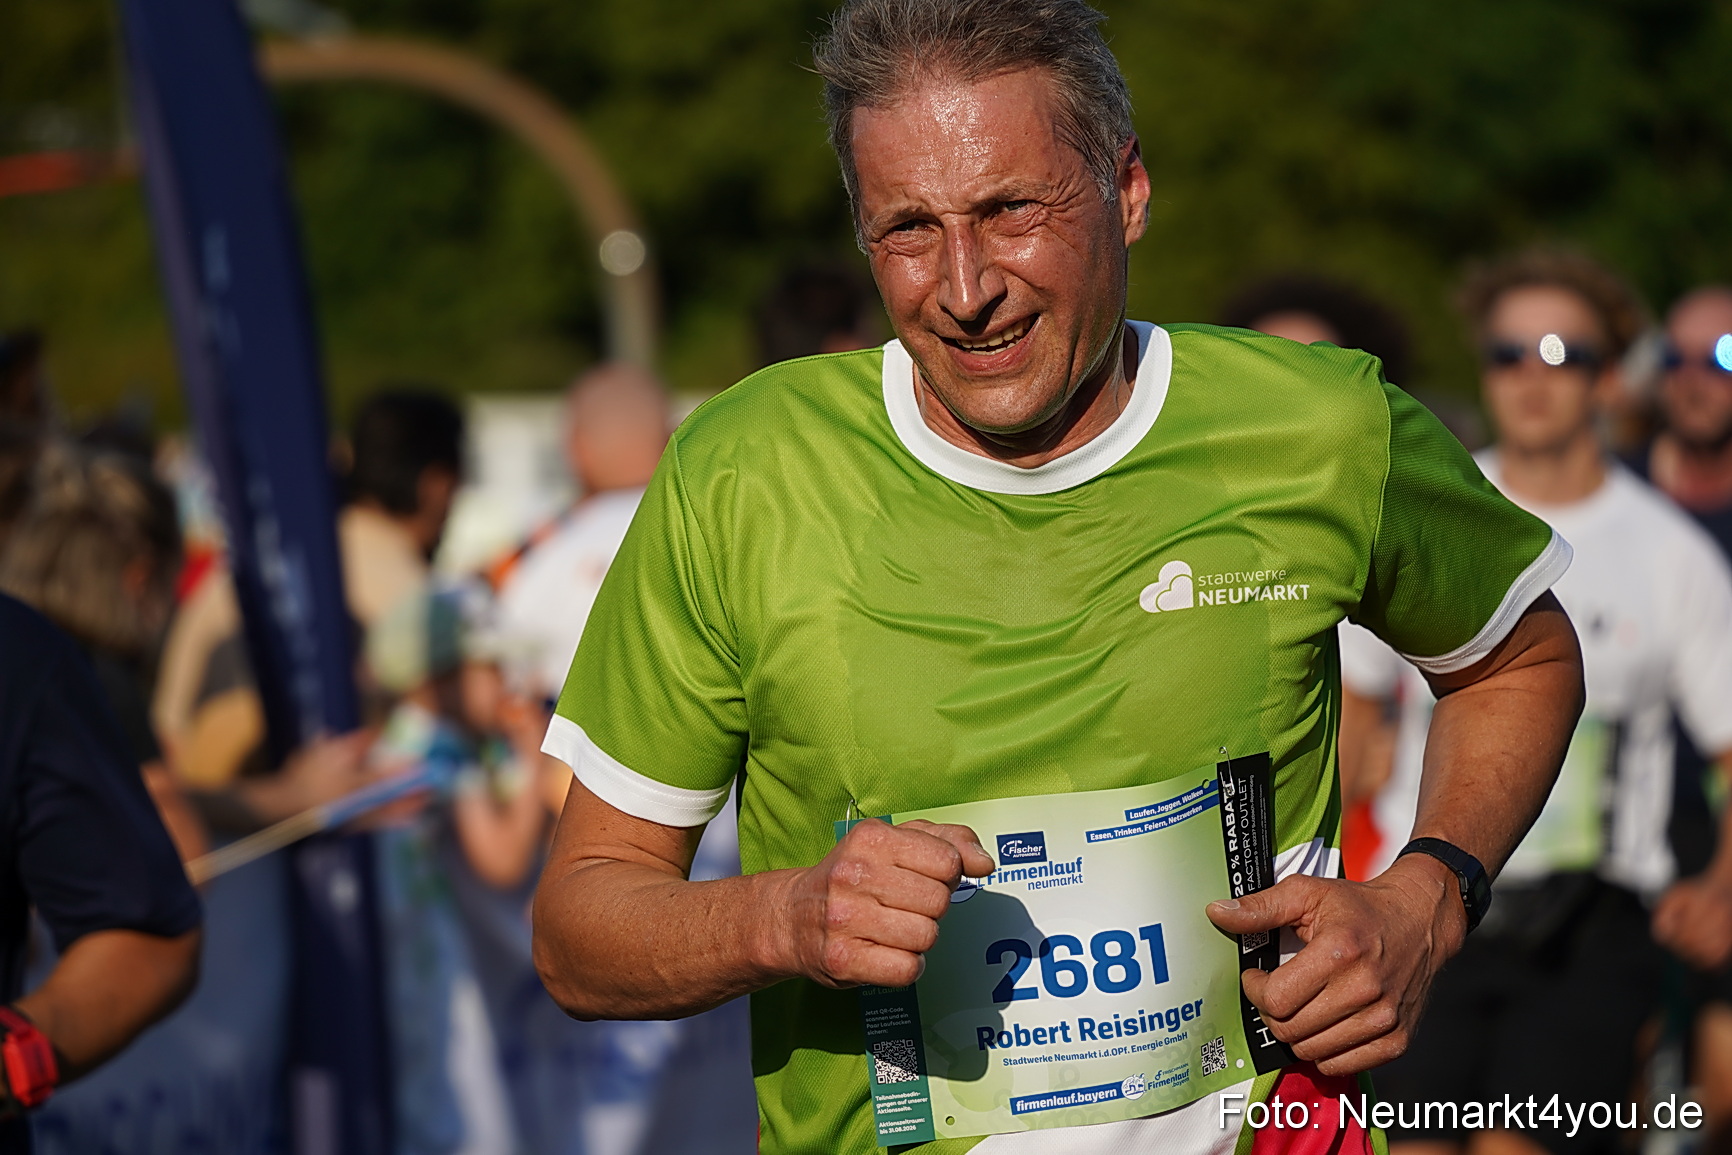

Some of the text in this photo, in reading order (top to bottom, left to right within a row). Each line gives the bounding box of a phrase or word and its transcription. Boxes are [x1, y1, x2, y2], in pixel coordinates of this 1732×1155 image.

[1198, 569, 1286, 587] stadtwerke
[1198, 584, 1310, 607] NEUMARKT
[1129, 789, 1204, 820] Laufen, Joggen, Walken
[1090, 805, 1203, 841] Essen, Trinken, Feiern, Netzwerken
[1238, 778, 1256, 892] FACTORY OUTLET
[1009, 840, 1043, 855] Fischer
[1012, 851, 1041, 859] AUTOMOBILE
[988, 857, 1083, 886] Firmenlauf
[1230, 854, 1241, 870] %
[1027, 873, 1084, 891] neumarkt
[1233, 873, 1245, 898] 20
[985, 922, 1170, 1004] 2681
[976, 998, 1204, 1051] Robert Reisinger
[1002, 1032, 1188, 1067] Stadtwerke Neumarkt i.d.OPf. Energie GmbH
[1147, 1069, 1190, 1090] Firmenlauf
[1015, 1087, 1118, 1112] firmenlauf.bayern
